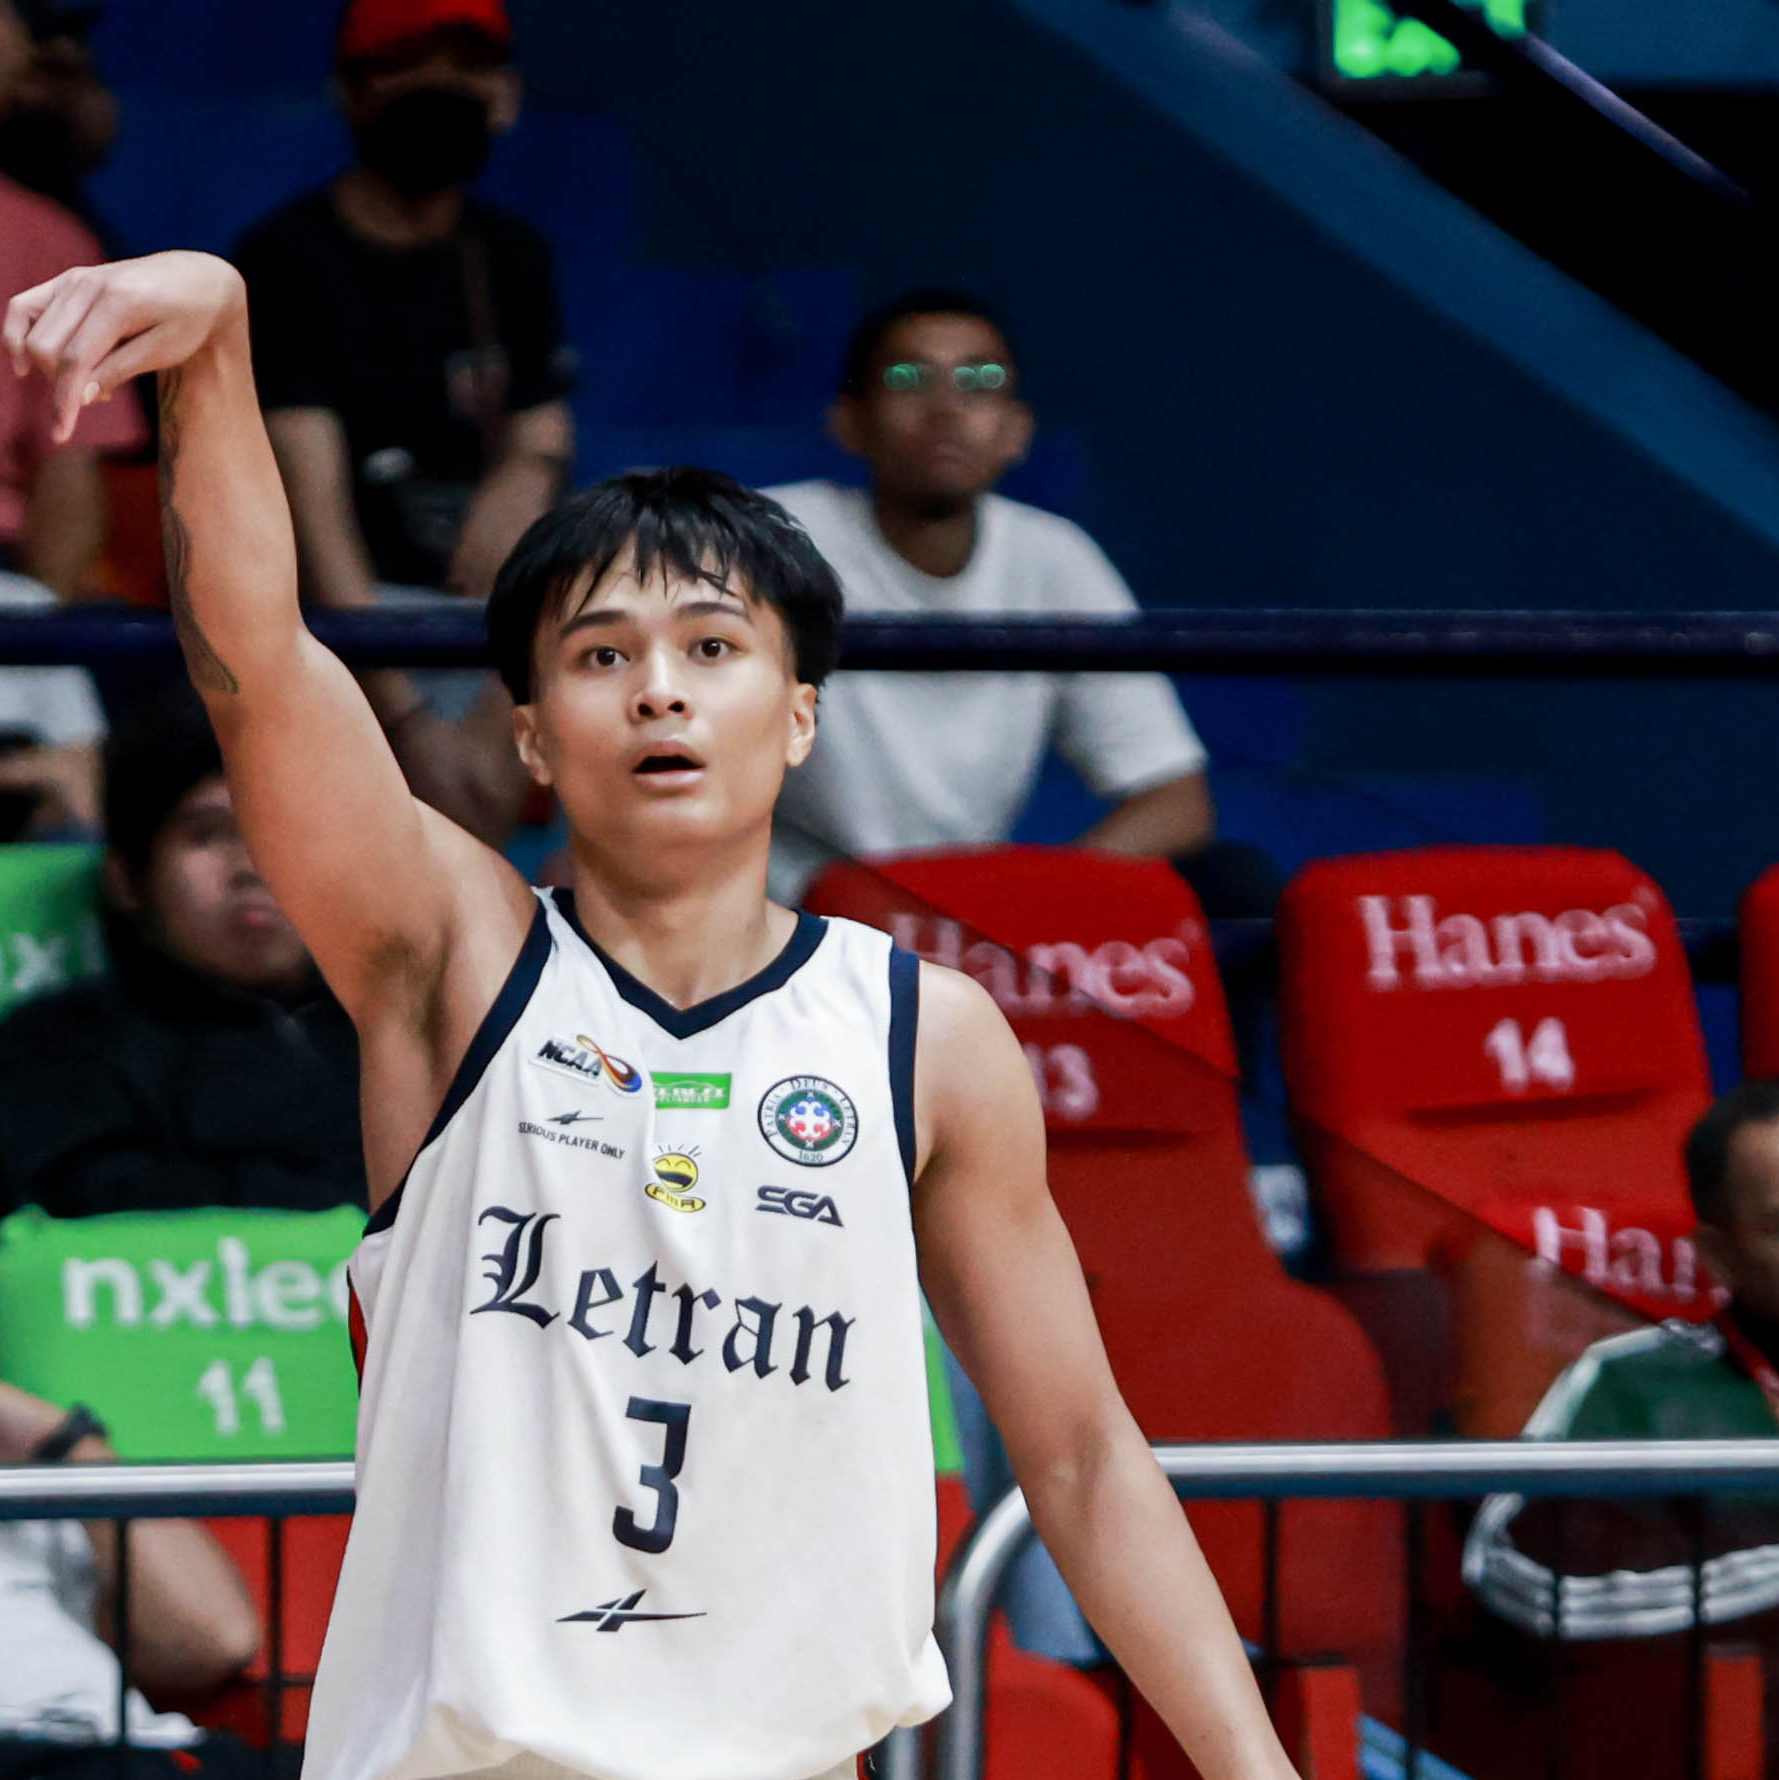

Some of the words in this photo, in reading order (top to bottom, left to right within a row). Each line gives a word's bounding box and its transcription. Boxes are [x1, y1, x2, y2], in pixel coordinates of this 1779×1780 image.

[1356, 893, 1658, 992] Hanes
[537, 1039, 603, 1078] NCAA
[1484, 1017, 1577, 1093] 14
[518, 1121, 557, 1142] SERIOUS
[558, 1133, 600, 1152] PLAYER
[600, 1142, 626, 1160] ONLY
[755, 1184, 845, 1228] SGA
[63, 1236, 354, 1332] nxle
[470, 1206, 857, 1392] Letran
[197, 1356, 286, 1437] 11
[613, 1396, 692, 1555] 3
